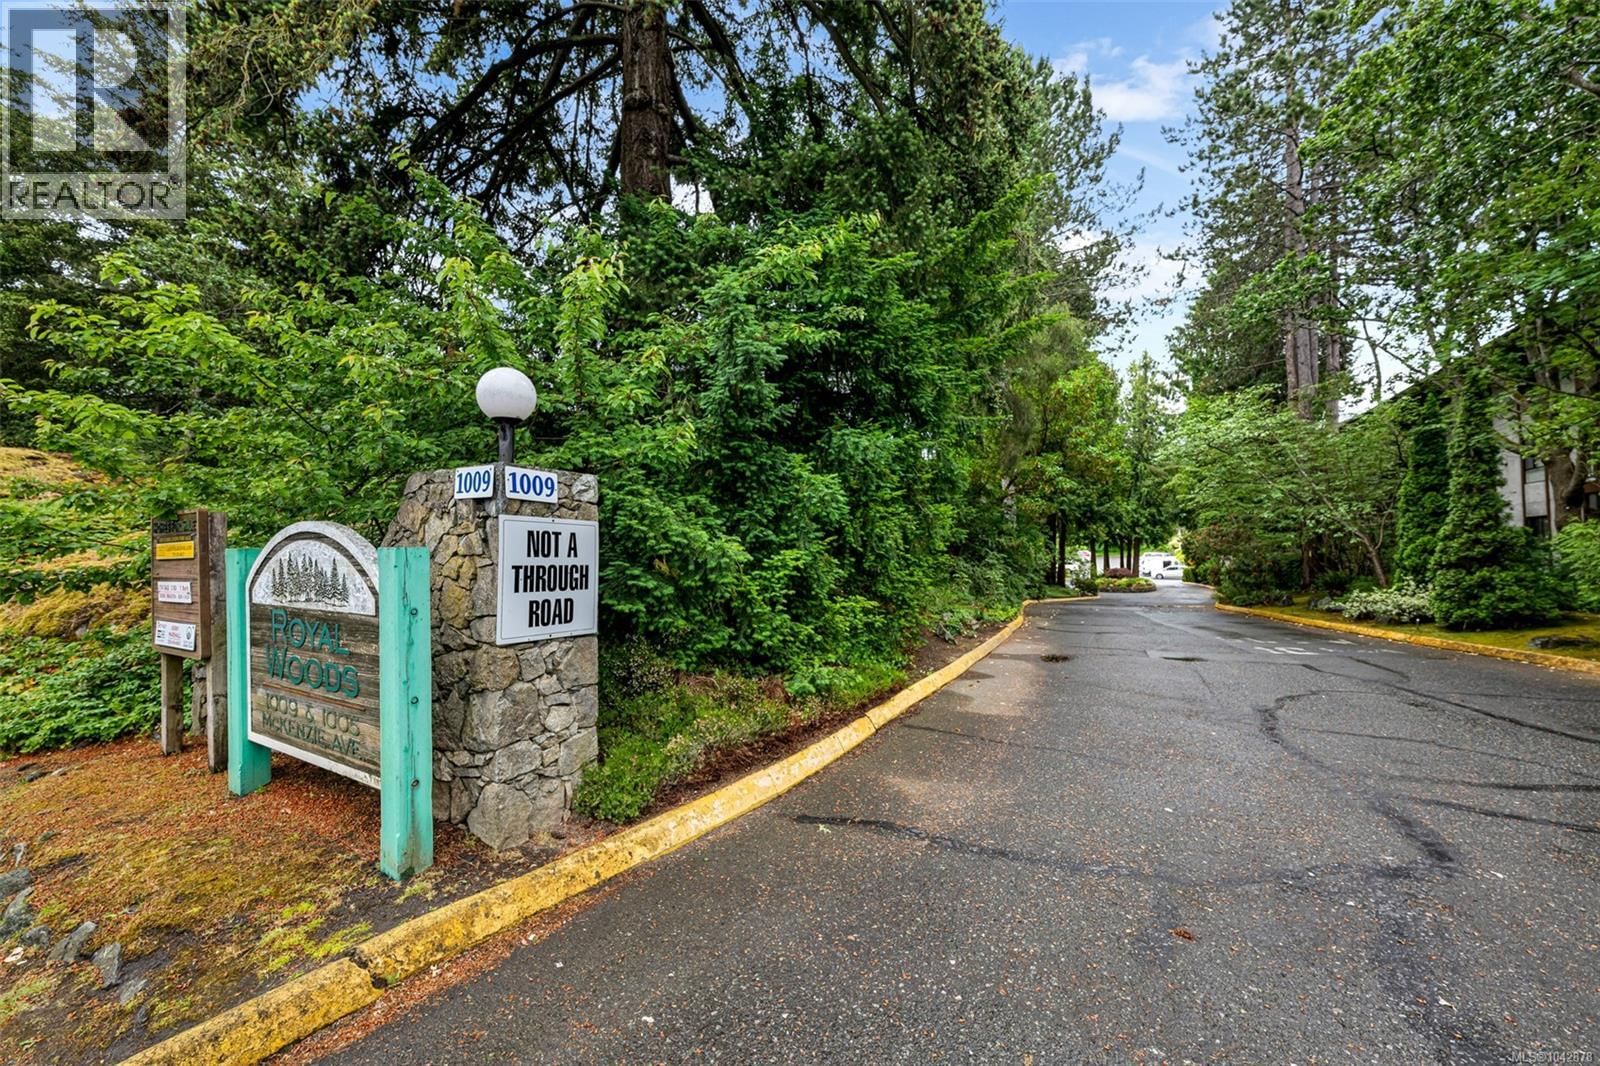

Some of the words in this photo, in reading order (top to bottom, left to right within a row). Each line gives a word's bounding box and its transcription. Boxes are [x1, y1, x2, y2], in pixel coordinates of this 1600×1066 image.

[456, 470, 491, 494] 1009
[508, 472, 555, 498] 1009
[527, 530, 562, 558] NOT
[567, 532, 578, 558] A
[512, 564, 589, 593] THROUGH
[528, 597, 574, 628] ROAD
[271, 608, 351, 656] ROYAL
[265, 644, 361, 699] WOODS
[266, 692, 298, 717] 1009
[305, 702, 315, 723] &
[322, 708, 361, 737] 1005
